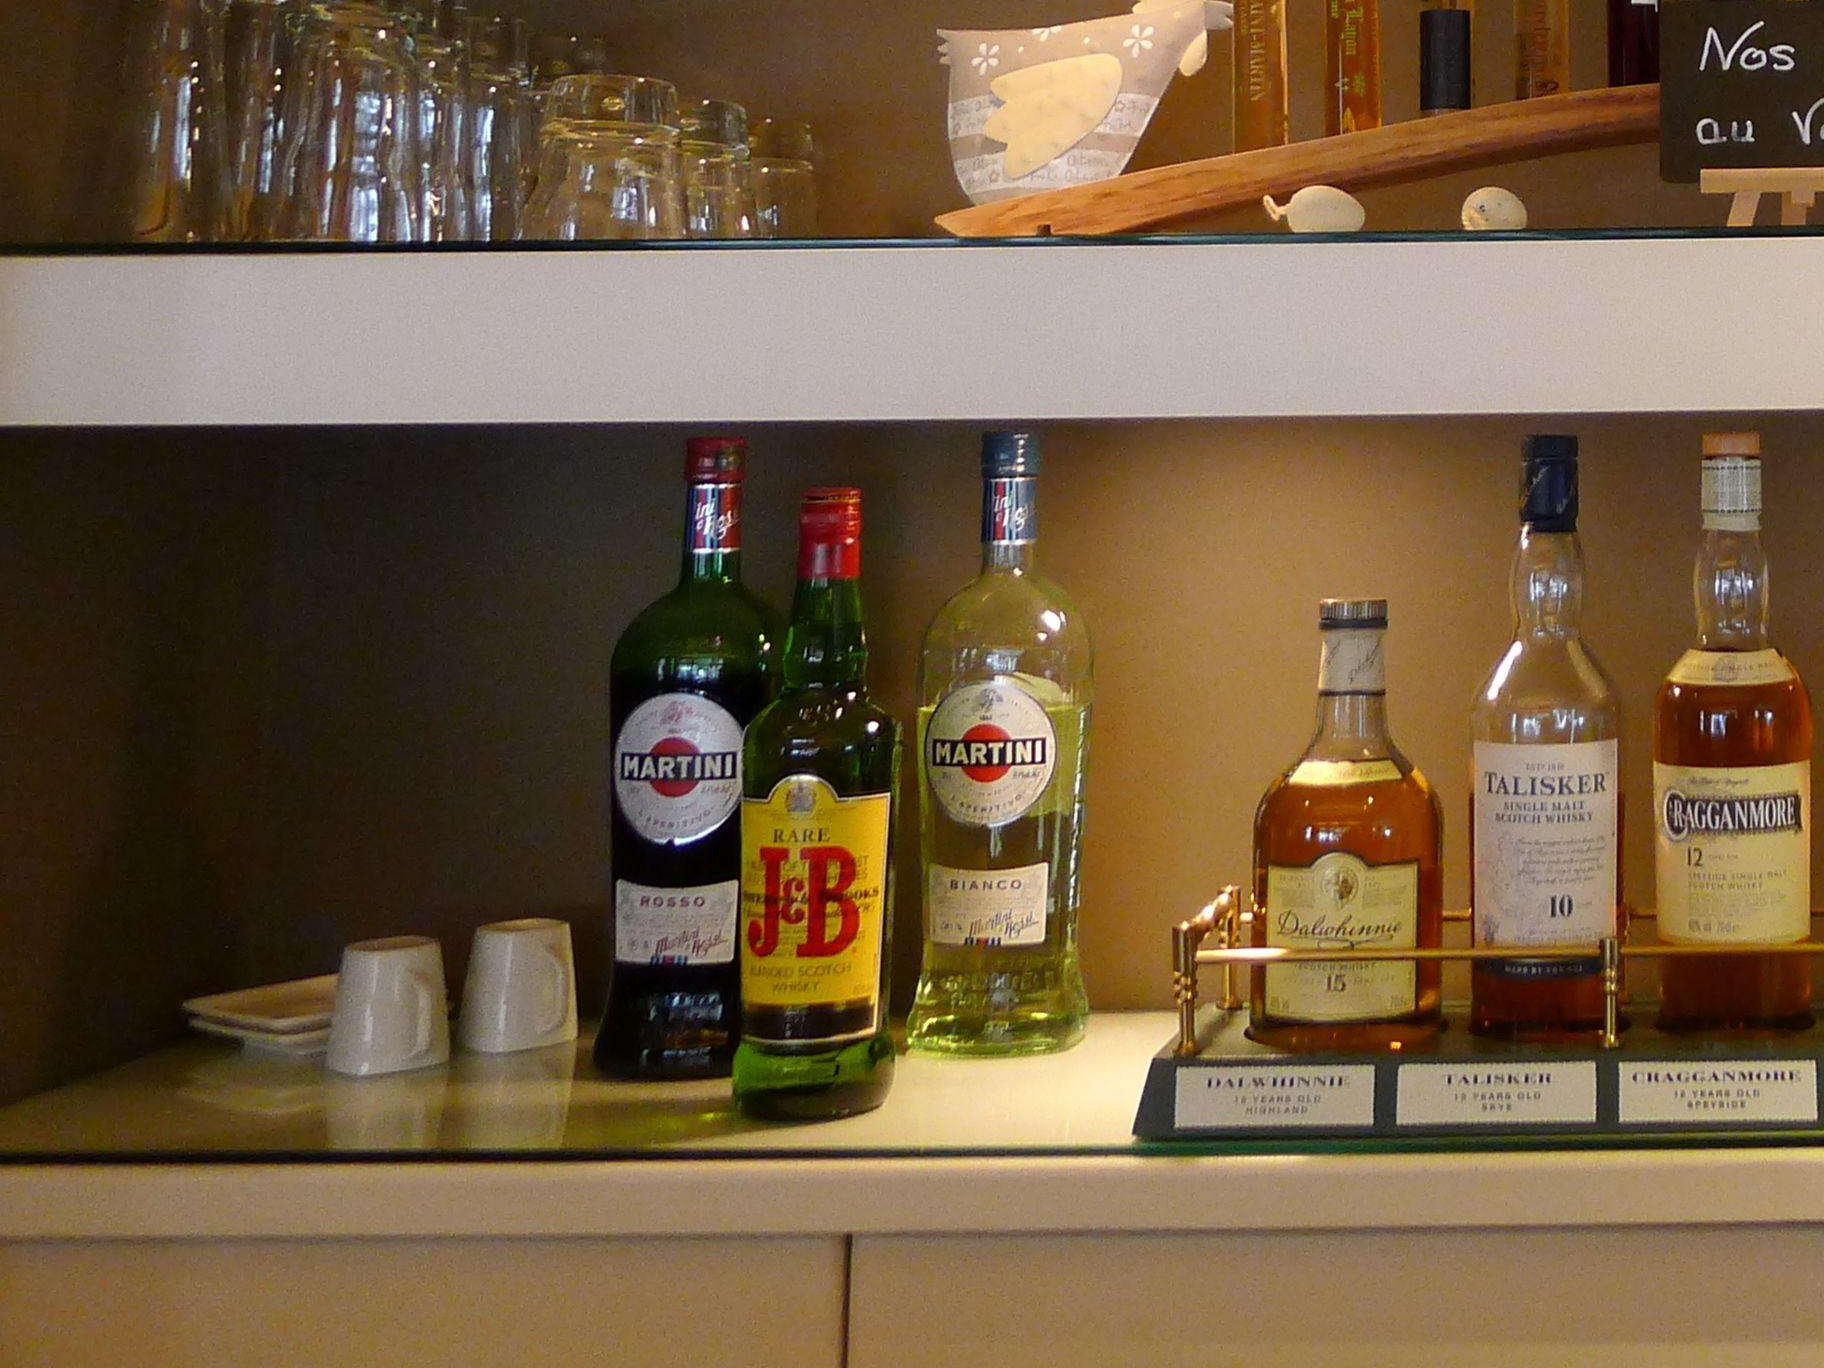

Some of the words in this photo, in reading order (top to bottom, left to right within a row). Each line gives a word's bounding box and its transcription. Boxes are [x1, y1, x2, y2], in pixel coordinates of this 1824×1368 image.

[1699, 20, 1795, 72] Nos
[1696, 118, 1755, 145] au
[934, 740, 1044, 766] MARTINI
[623, 753, 733, 779] MARTINI
[1484, 771, 1607, 797] TALISKER
[1502, 801, 1548, 812] SINGLE
[1552, 800, 1586, 811] MALT
[1495, 813, 1542, 824] SCOTCH
[1546, 812, 1594, 824] WHISKY
[1664, 790, 1797, 841] CRAGGANMORE
[772, 828, 831, 843] RARE
[1687, 846, 1704, 867] 12
[950, 878, 1023, 891] BIANCO
[639, 895, 706, 908] ROSSO
[1549, 894, 1574, 919] 10
[1325, 973, 1347, 993] 15
[1206, 1075, 1351, 1089] DALWHINNIE
[1444, 1073, 1552, 1085] TALISKER
[1631, 1070, 1801, 1083] CRAGGANMORE
[1253, 1094, 1292, 1104] YEARS
[1296, 1093, 1322, 1104] OLD
[1472, 1091, 1512, 1101] YEARS
[1516, 1091, 1542, 1101] OLD
[1691, 1089, 1731, 1099] YEARS
[1736, 1088, 1761, 1098] OLD
[1245, 1105, 1309, 1115] HIGHLAND
